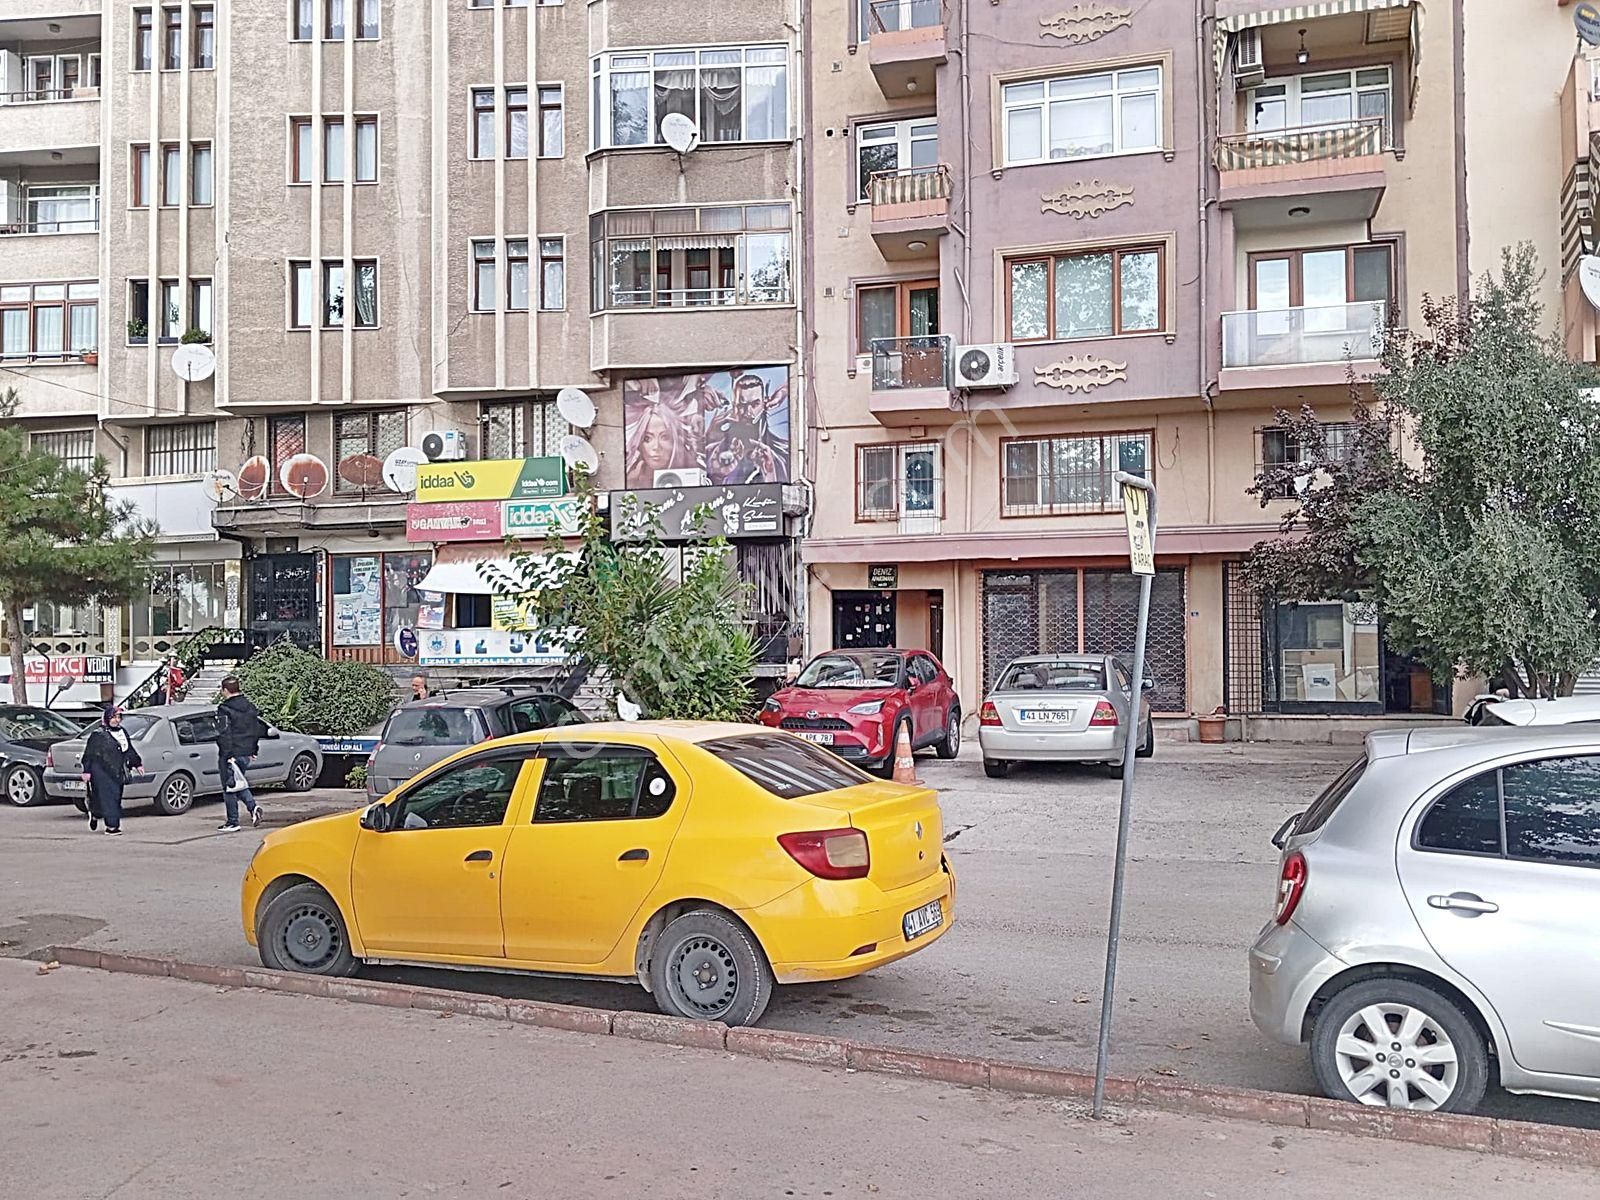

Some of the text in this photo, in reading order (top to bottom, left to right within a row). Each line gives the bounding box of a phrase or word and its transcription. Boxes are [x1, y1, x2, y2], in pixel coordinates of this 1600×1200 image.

[420, 474, 455, 489] iddaa
[509, 506, 555, 525] iddaa
[86, 657, 112, 675] VEDAT
[1026, 712, 1066, 720] 41 LN 765
